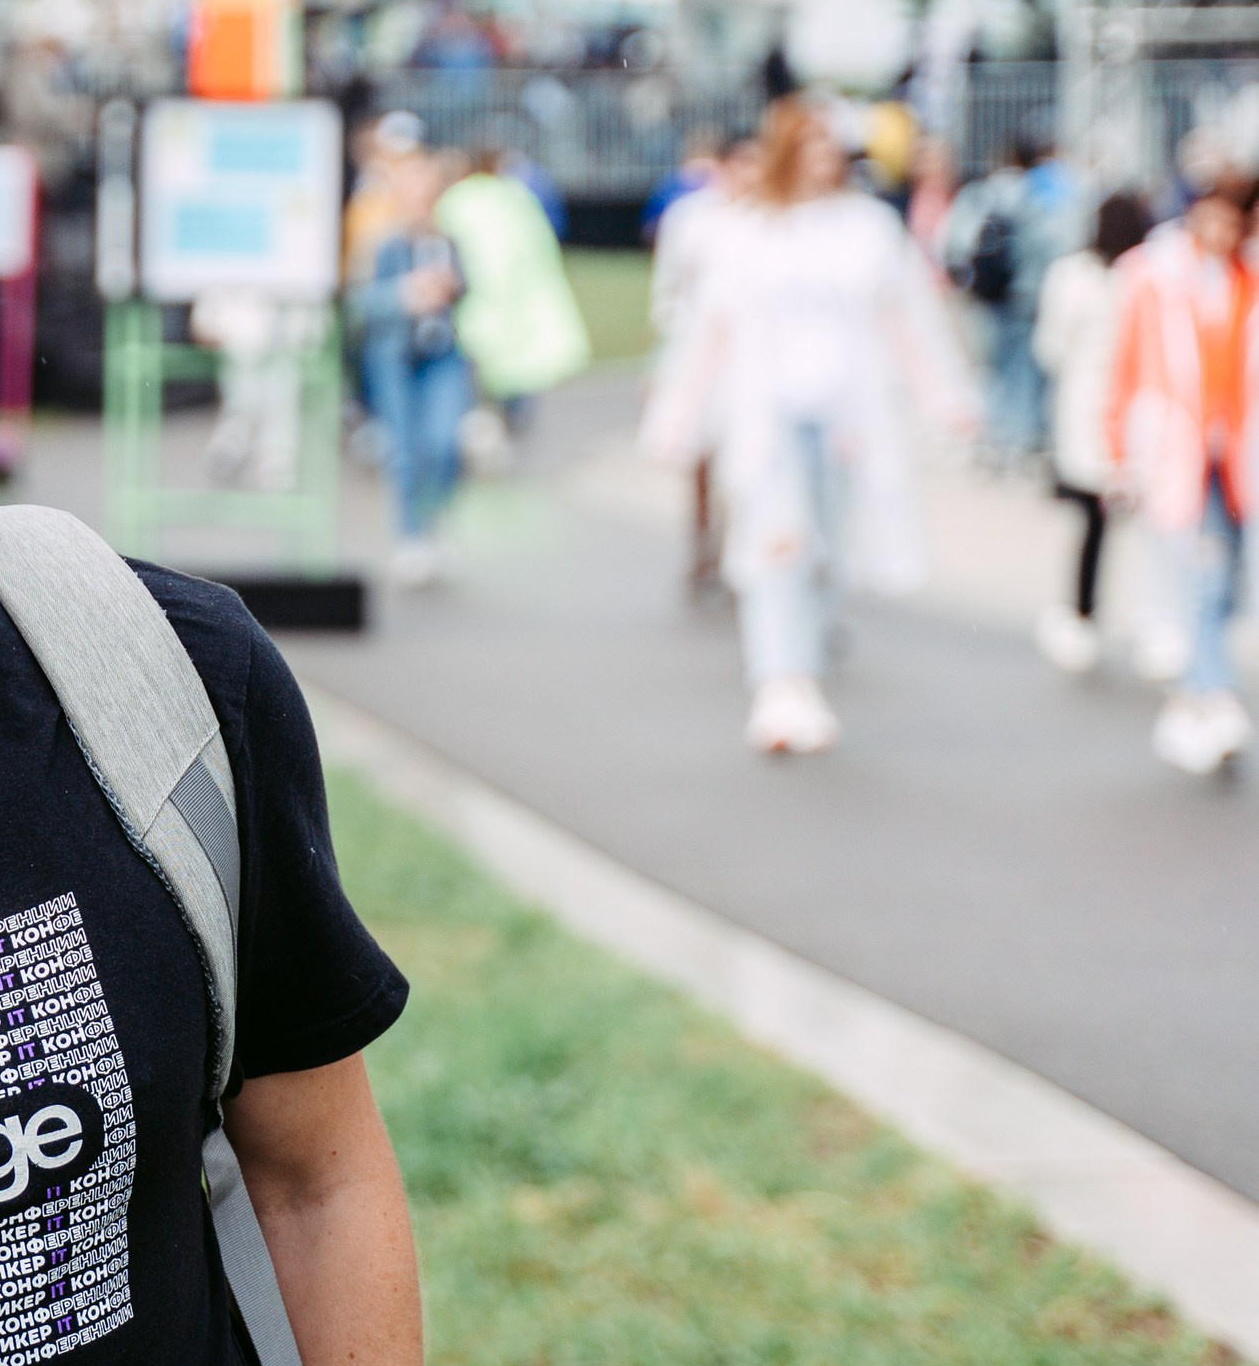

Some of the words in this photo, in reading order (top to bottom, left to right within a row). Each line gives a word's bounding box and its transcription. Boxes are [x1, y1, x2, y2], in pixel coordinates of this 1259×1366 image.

[10, 908, 83, 949] КОНФЕ
[19, 944, 93, 984] КОНФЕ
[6, 1008, 25, 1026] IT
[30, 980, 104, 1019] КОНФЕ
[17, 1042, 36, 1061] IT
[41, 1015, 114, 1054] КОНФЕ
[70, 1154, 137, 1193] КОНФЕ
[47, 1215, 64, 1231] IT
[69, 1187, 133, 1225] КОНФЕ
[51, 1248, 67, 1265] IT
[71, 1215, 128, 1257] КОНФЕ
[51, 1281, 66, 1299] IT
[70, 1250, 129, 1292] КОНФЕ
[56, 1315, 72, 1334] IT
[76, 1284, 131, 1327] КОНФЕ
